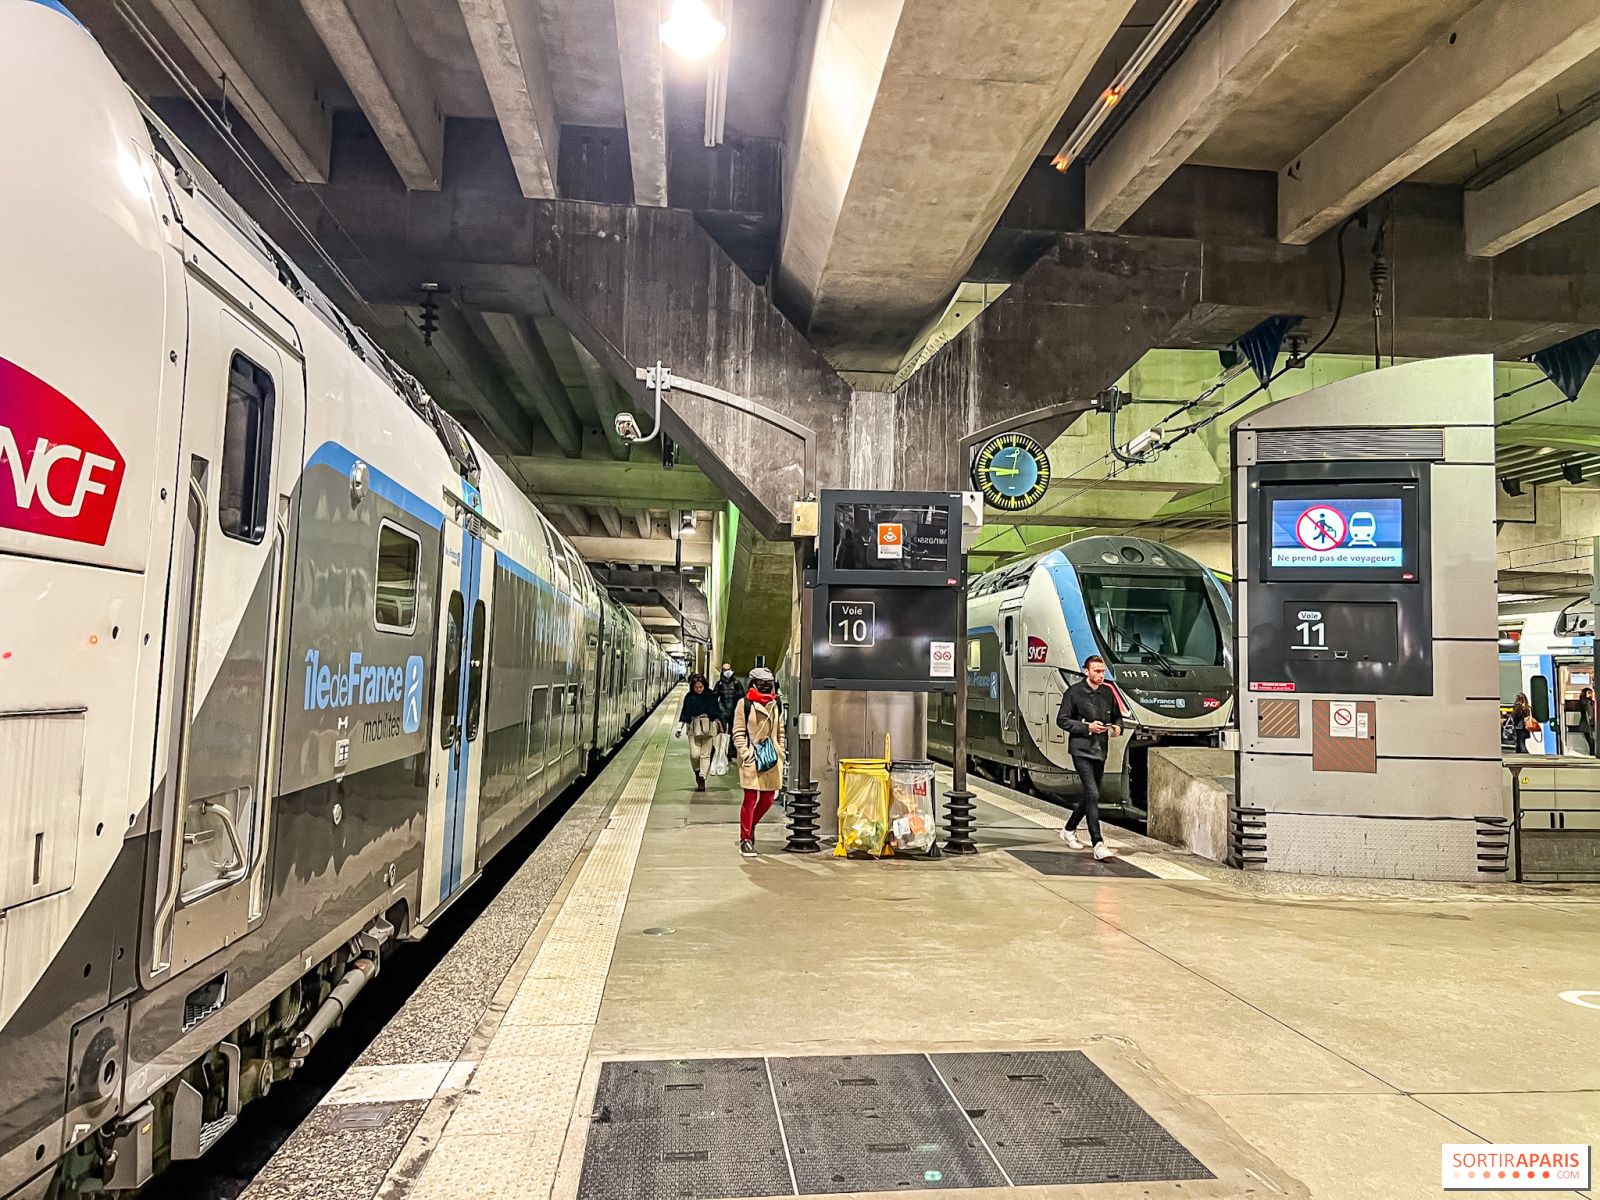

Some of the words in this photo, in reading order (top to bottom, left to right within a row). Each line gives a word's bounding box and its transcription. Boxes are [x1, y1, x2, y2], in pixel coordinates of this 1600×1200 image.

[1277, 554, 1289, 562] Ne
[1292, 554, 1317, 563] prend
[1320, 555, 1335, 563] pas
[1337, 554, 1348, 562] de
[1350, 555, 1396, 563] voyageurs
[842, 606, 863, 615] Voie
[1301, 612, 1319, 620] Voie
[838, 619, 867, 641] 10
[1295, 621, 1325, 646] 11
[1028, 646, 1047, 660] SNCF
[1122, 670, 1138, 678] 111
[1203, 700, 1220, 708] SNCF
[362, 707, 401, 743] mobilités
